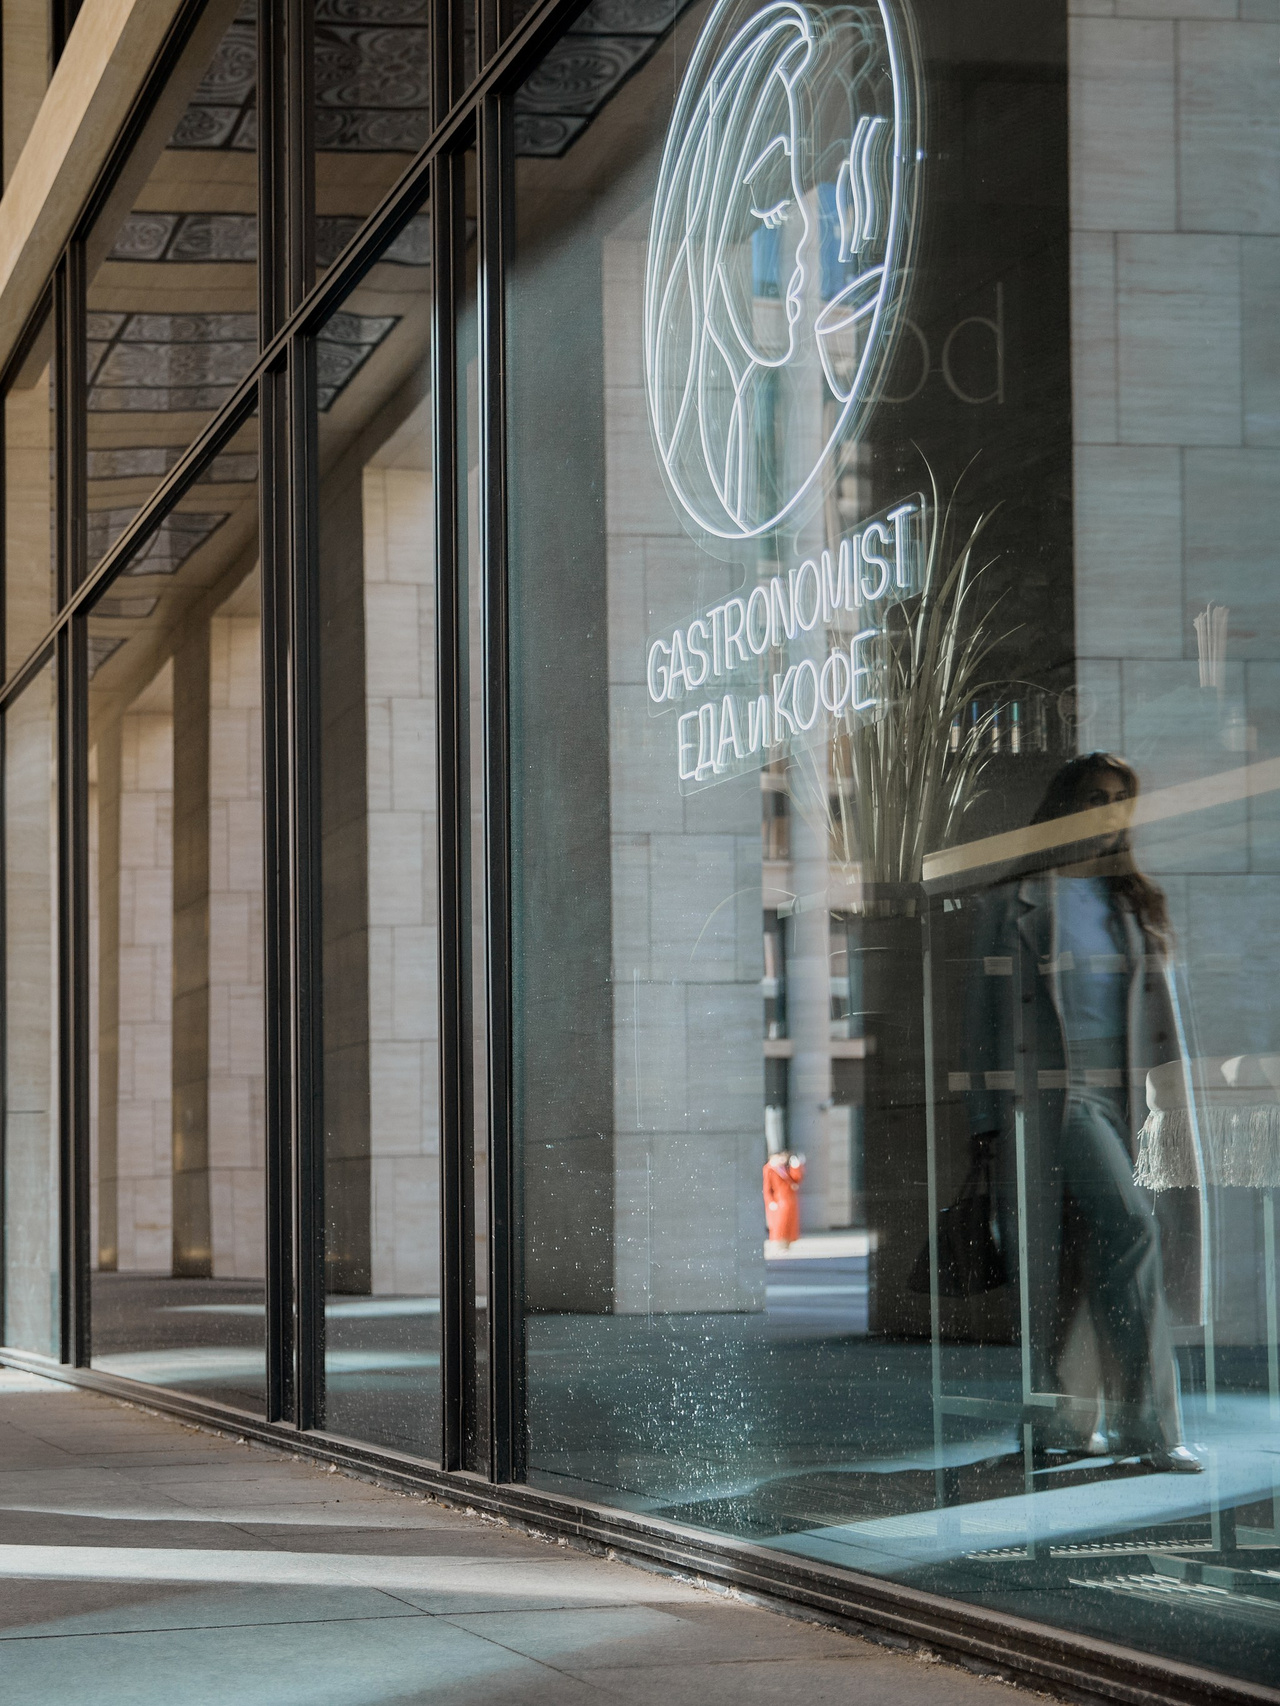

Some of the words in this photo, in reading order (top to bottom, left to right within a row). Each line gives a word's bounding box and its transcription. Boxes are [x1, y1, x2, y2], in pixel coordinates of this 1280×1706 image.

[647, 504, 918, 702] GASTRONOMIST
[677, 694, 746, 782] ЕДА
[773, 629, 880, 742] КОФЕ
